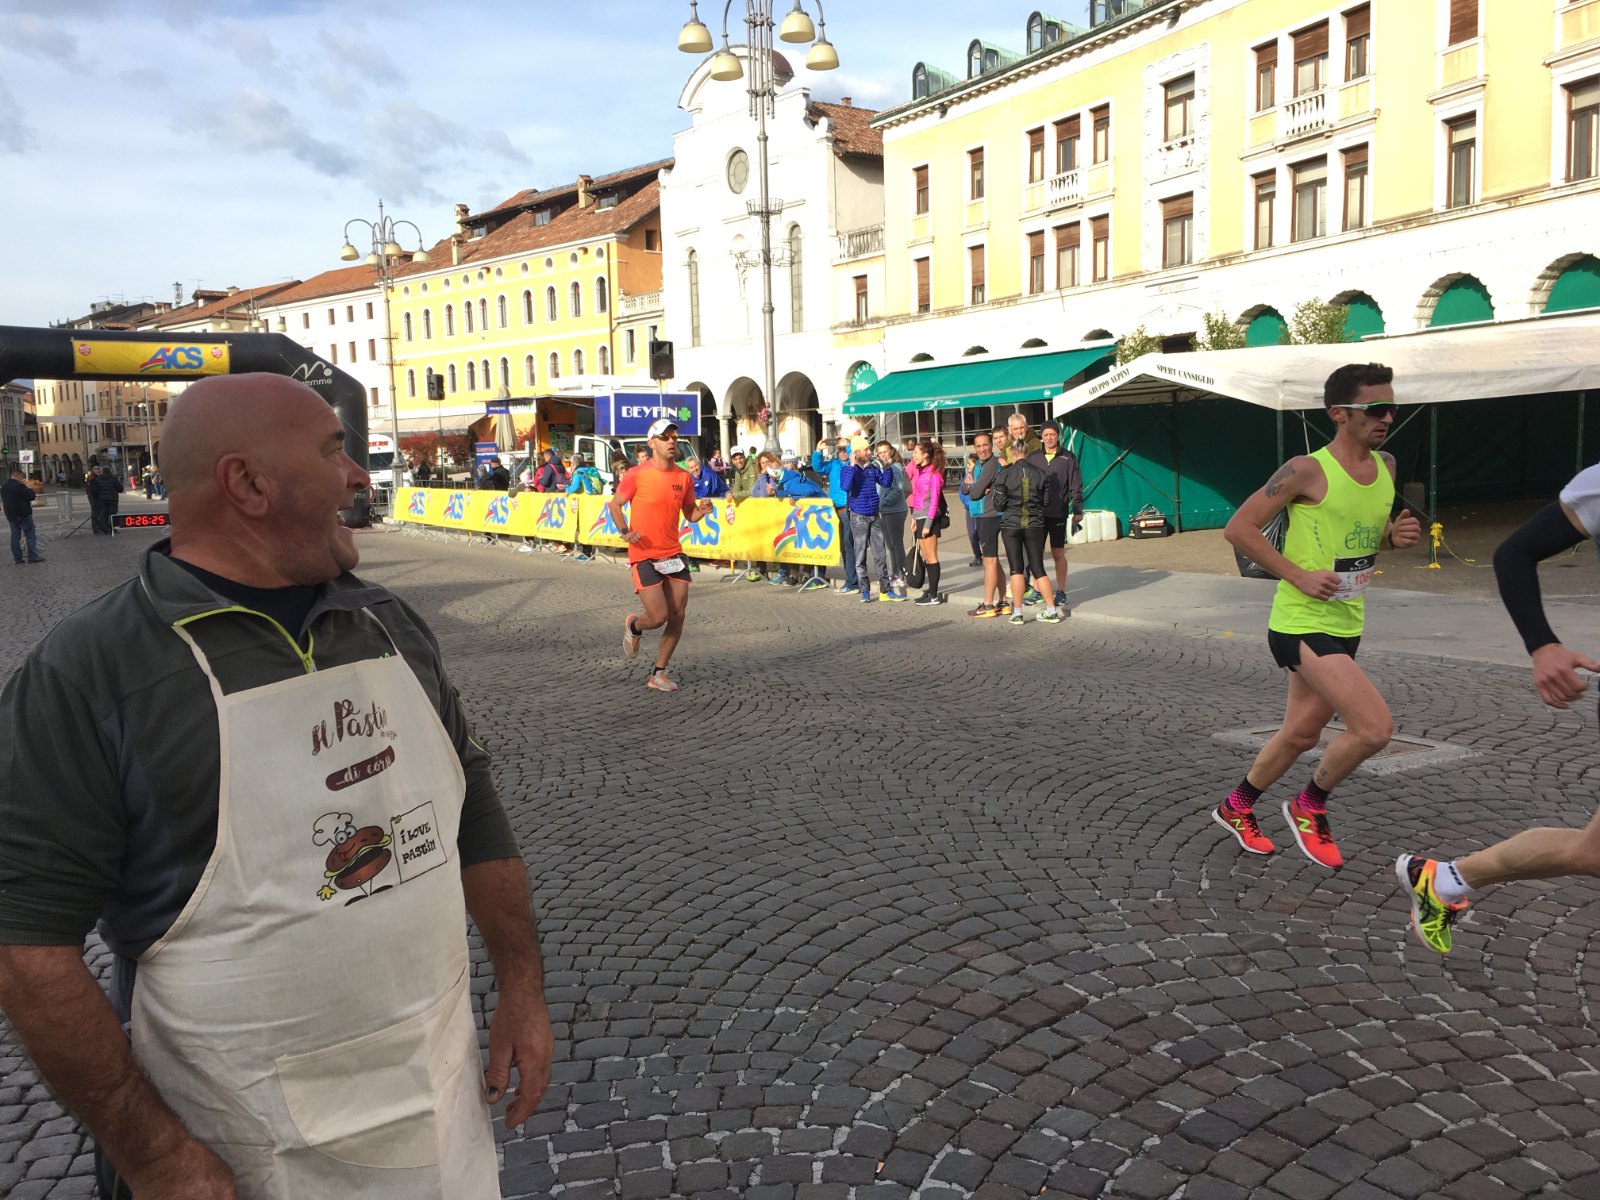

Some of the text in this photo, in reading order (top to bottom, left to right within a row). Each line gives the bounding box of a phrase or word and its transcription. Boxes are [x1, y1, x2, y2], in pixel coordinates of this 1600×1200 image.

[1088, 367, 1131, 396] GRUPPO ALPINI
[1178, 369, 1215, 386] CANSIGLIO
[621, 405, 678, 418] BEYFIN
[407, 822, 432, 842] LOVE
